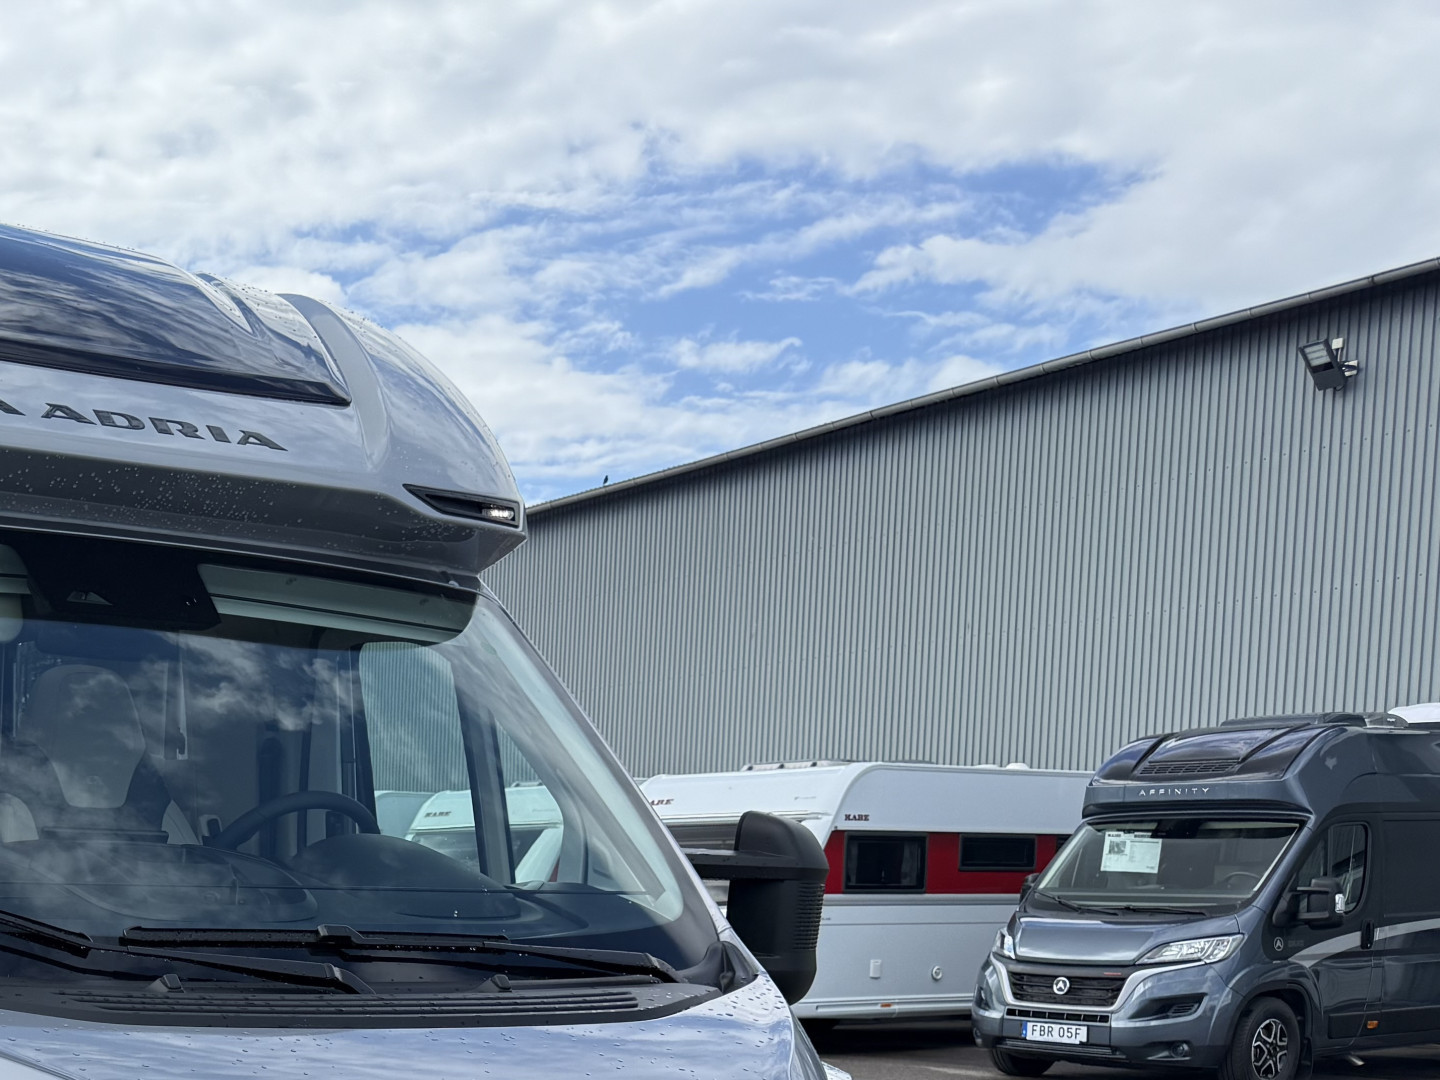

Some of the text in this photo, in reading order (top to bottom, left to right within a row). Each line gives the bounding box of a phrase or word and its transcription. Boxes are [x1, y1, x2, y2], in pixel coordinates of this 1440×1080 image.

[41, 402, 289, 452] ADRIA
[1138, 787, 1210, 796] AFFINITY
[649, 798, 675, 806] ABE
[1031, 1024, 1081, 1040] FBR 05F
